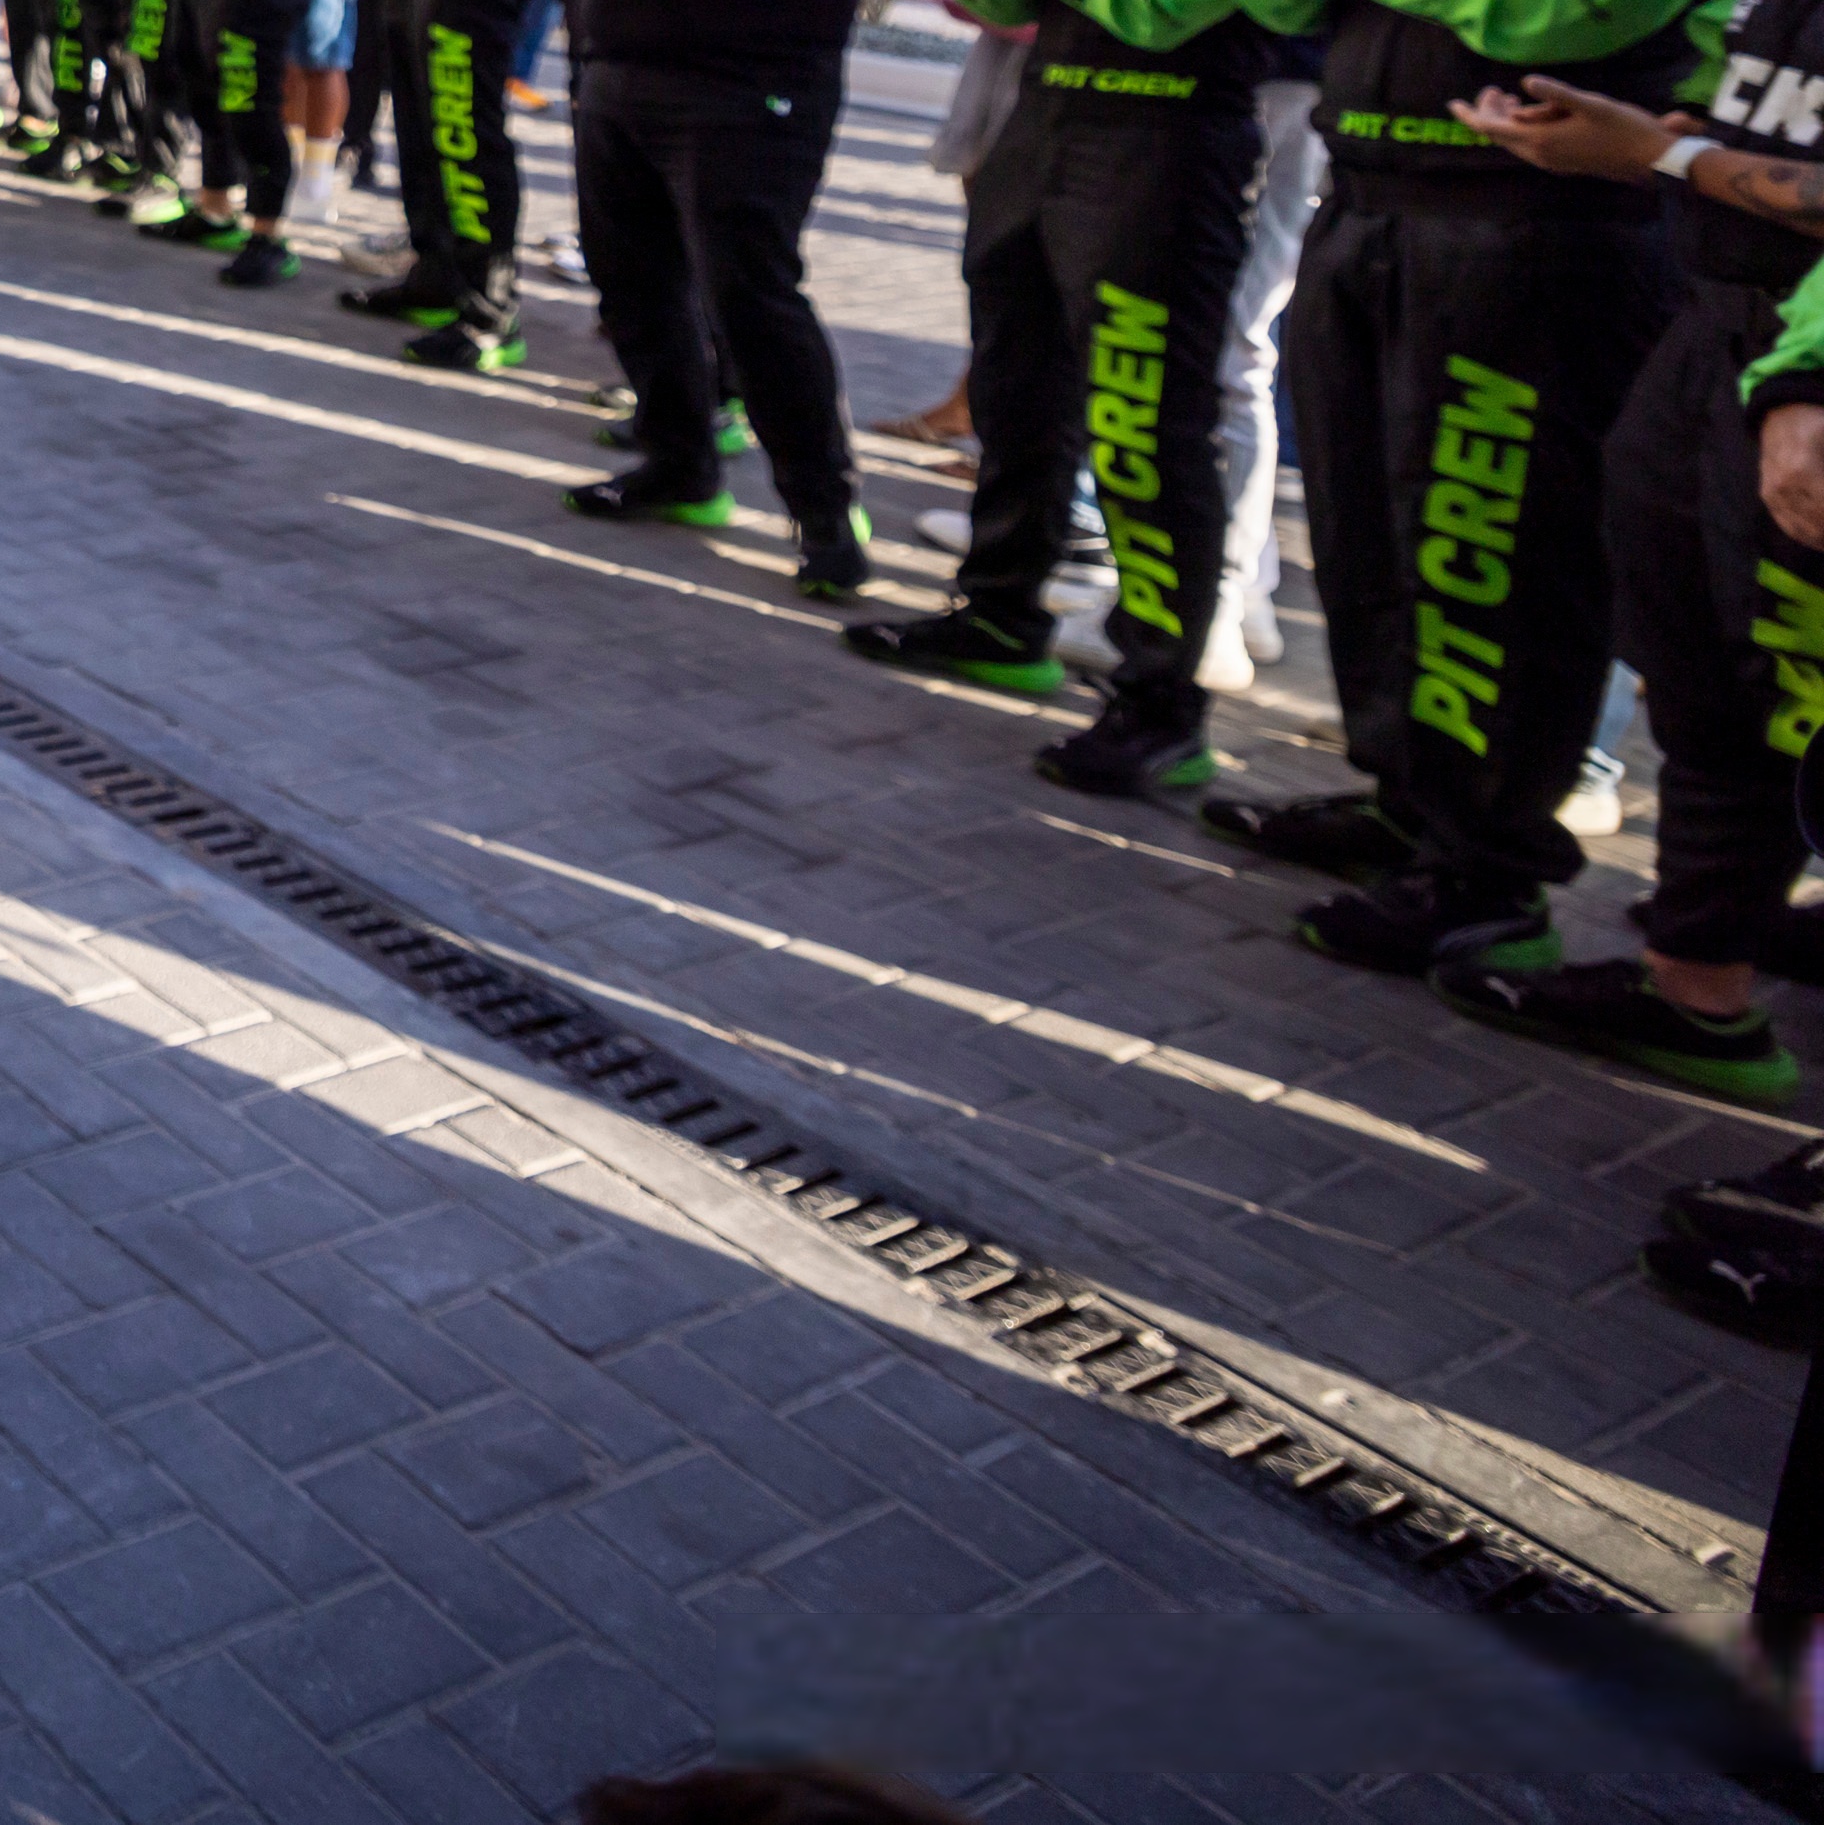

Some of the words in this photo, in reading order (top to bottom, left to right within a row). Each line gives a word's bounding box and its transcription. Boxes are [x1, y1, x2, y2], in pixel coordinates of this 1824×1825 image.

[426, 22, 478, 162] CREW
[440, 158, 493, 245] PIT
[1086, 278, 1170, 503] CREW
[1416, 353, 1539, 607] CREW
[1104, 500, 1184, 638] PIT
[1410, 600, 1506, 758] PIT
